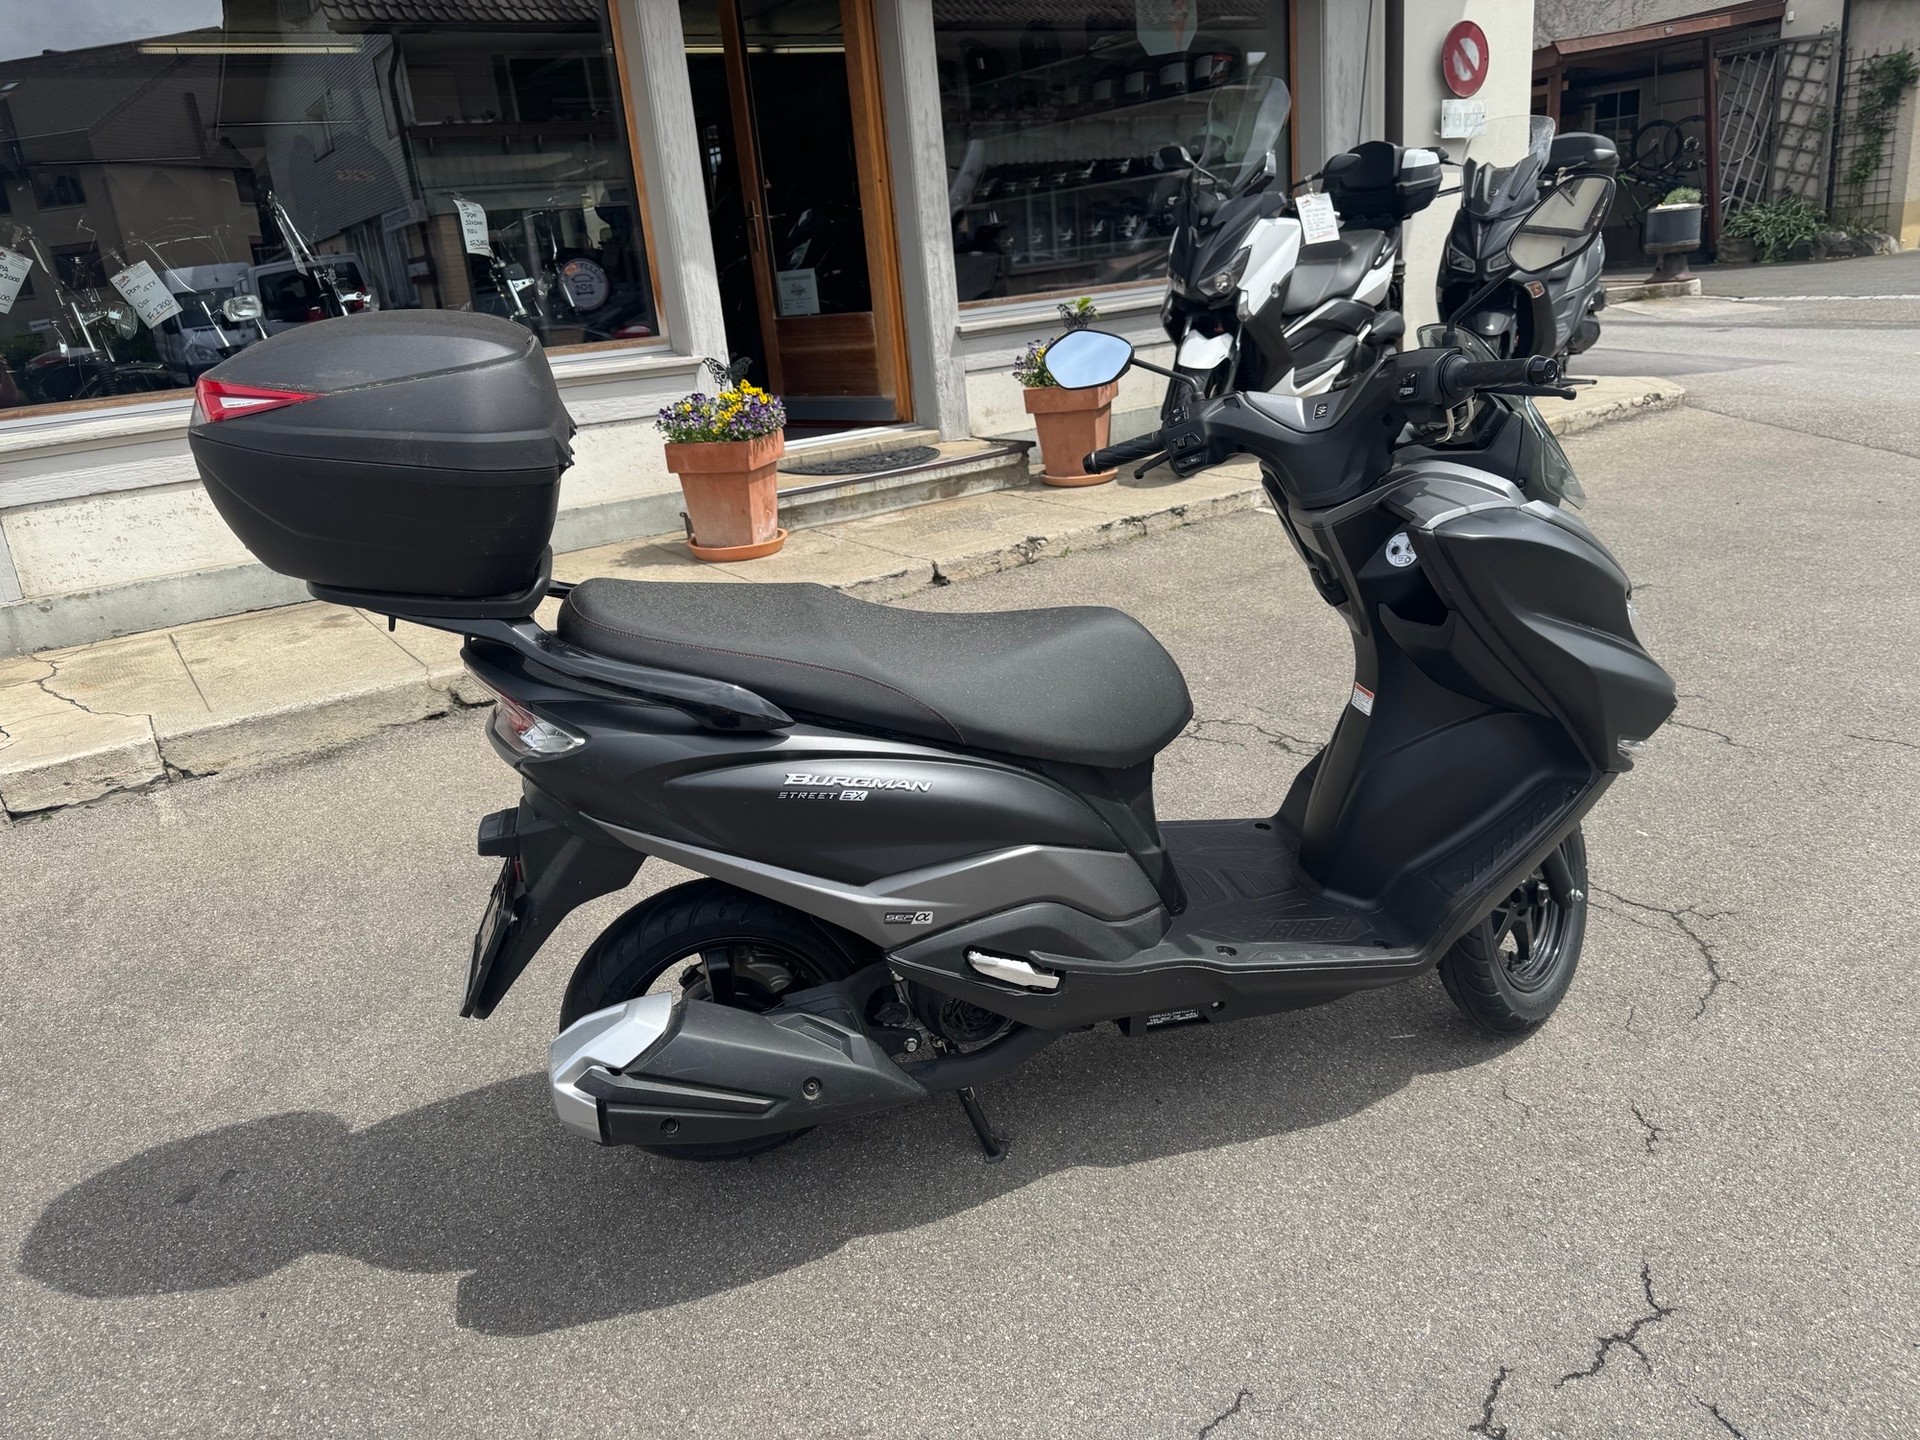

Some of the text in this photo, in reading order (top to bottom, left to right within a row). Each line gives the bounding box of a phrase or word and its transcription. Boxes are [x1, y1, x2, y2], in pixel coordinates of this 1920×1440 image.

[783, 773, 932, 792] BURGMAN
[777, 790, 867, 801] STREET EX
